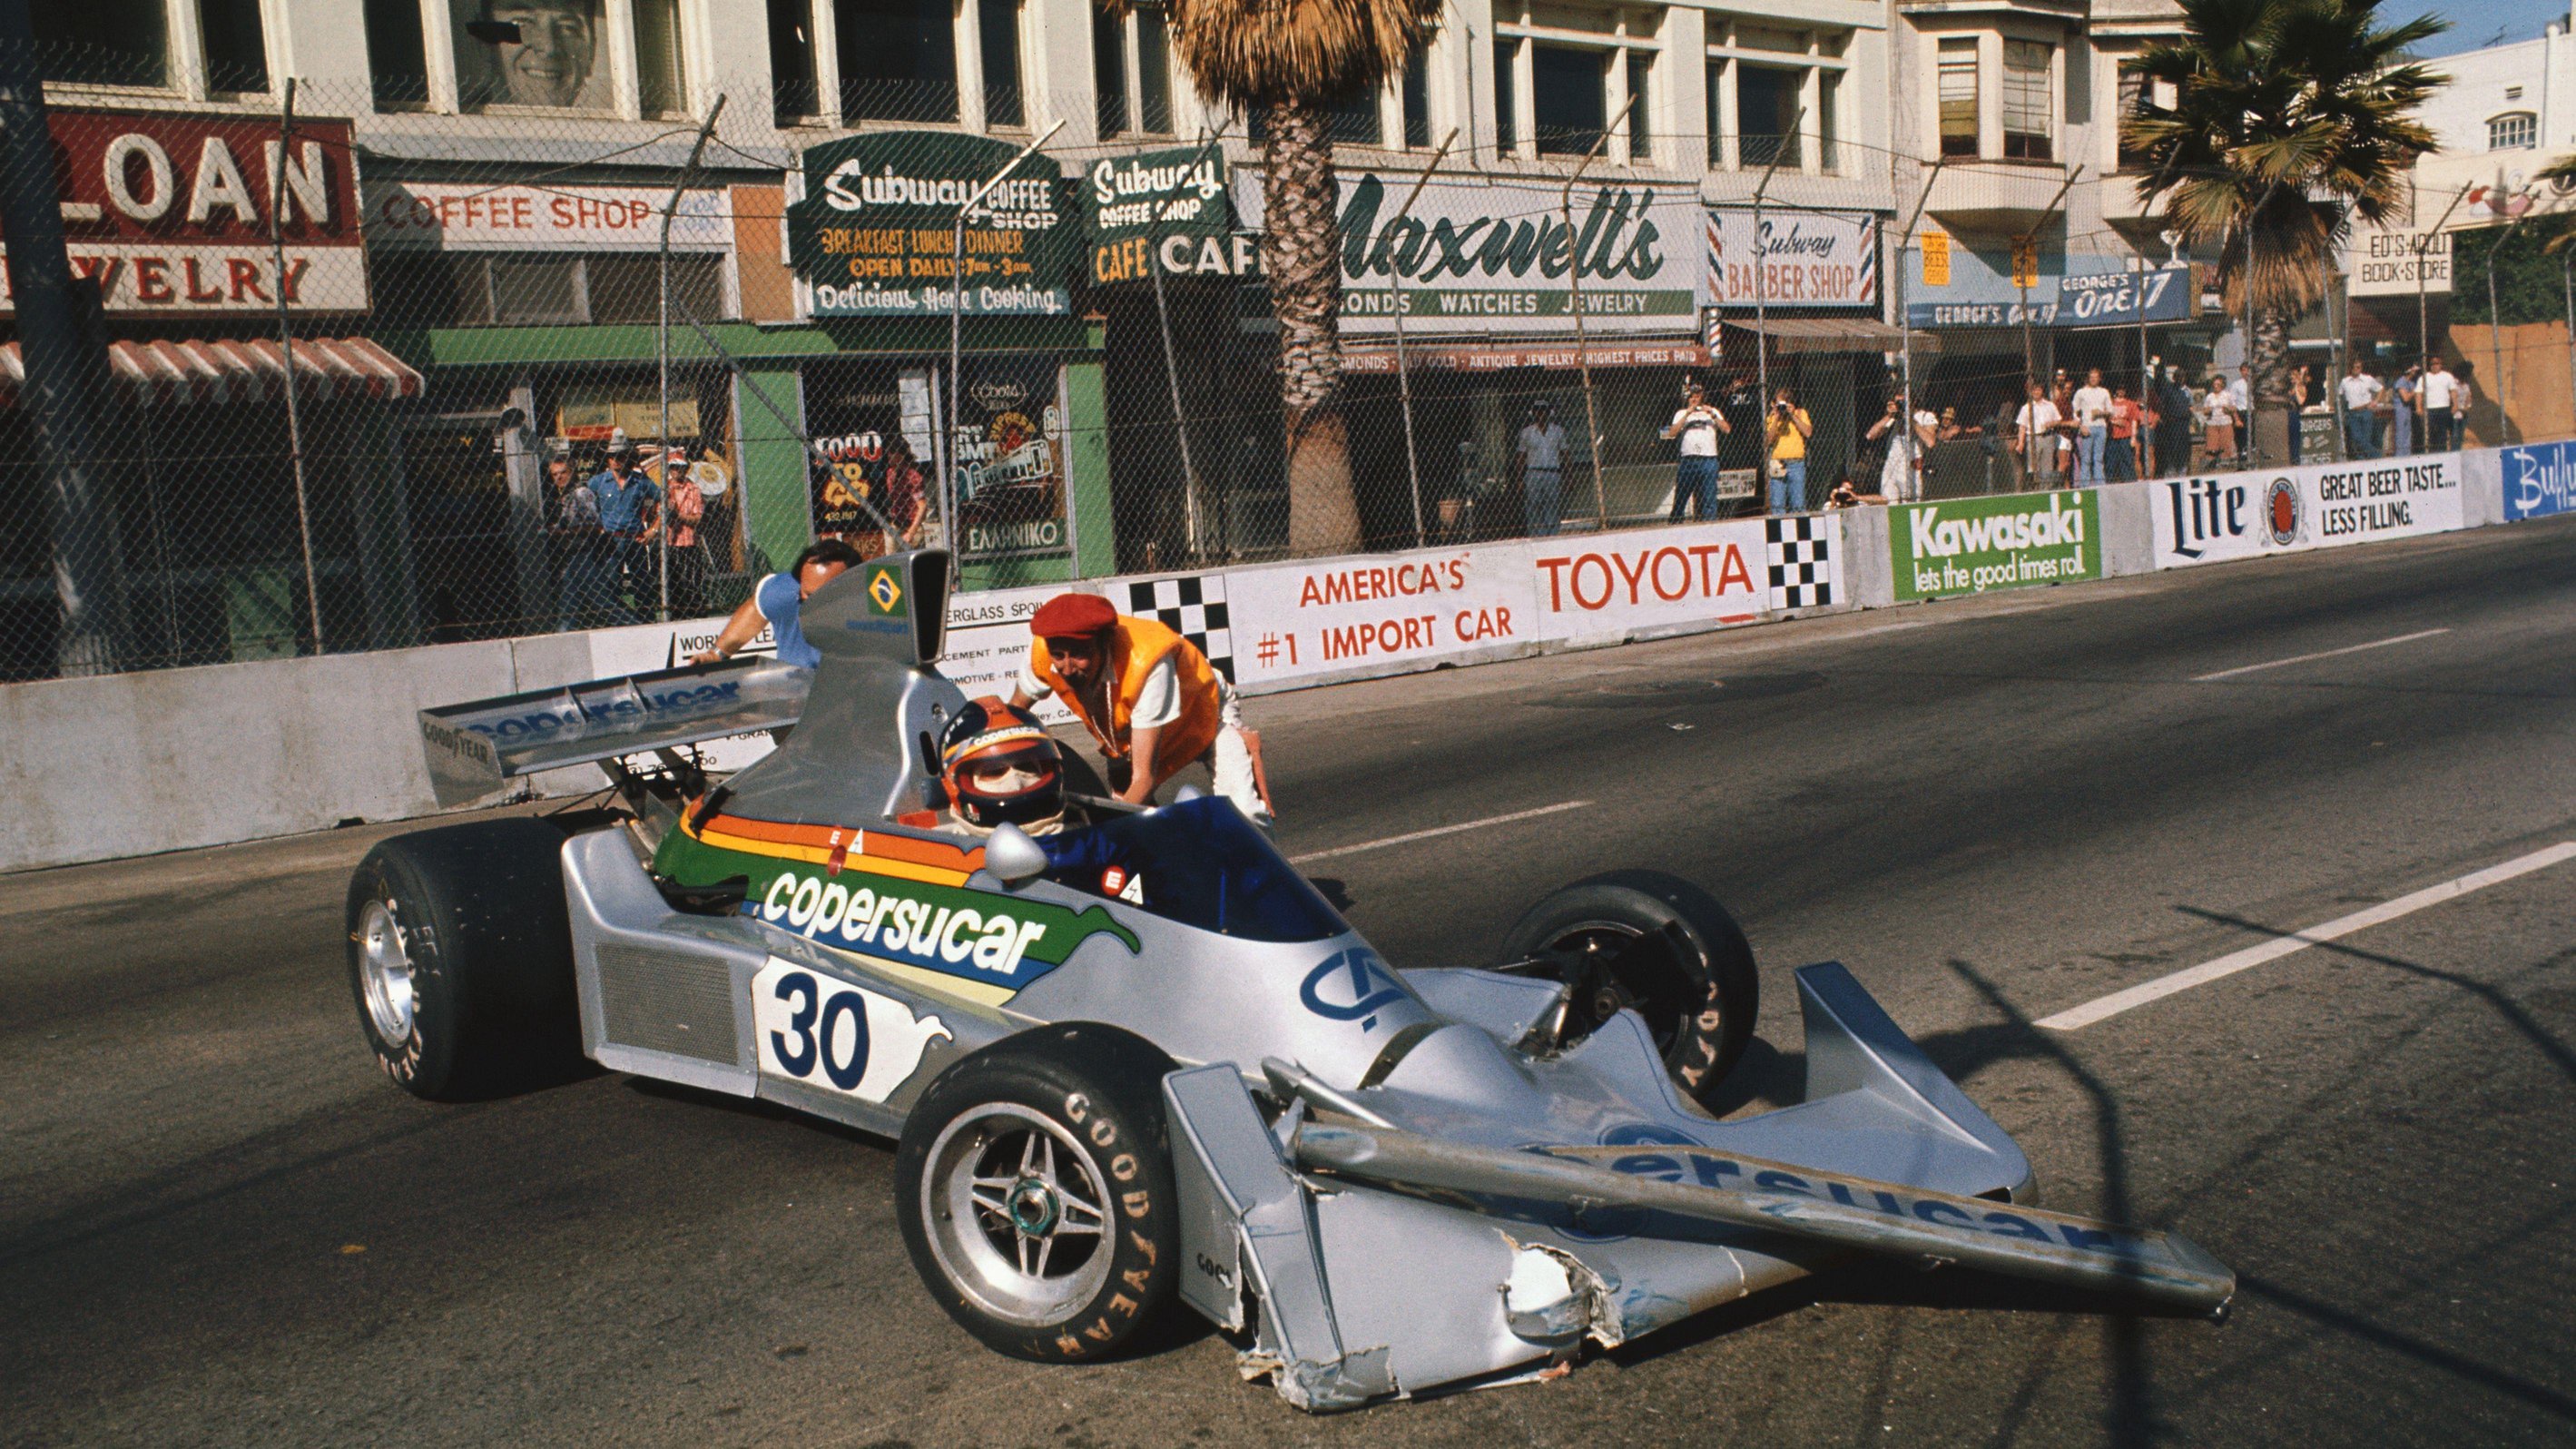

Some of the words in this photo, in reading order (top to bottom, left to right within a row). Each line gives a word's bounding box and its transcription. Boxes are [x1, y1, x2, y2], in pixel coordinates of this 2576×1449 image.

[824, 159, 991, 224] Subway
[988, 180, 1052, 211] COFFEE
[1094, 160, 1222, 203] Subway
[382, 195, 532, 229] COFFEE
[552, 199, 650, 229] SHOP
[991, 212, 1058, 229] SHOP
[1099, 202, 1151, 228] COFFEE
[821, 229, 906, 255] BREAKFAST
[911, 230, 954, 253] LUNCH
[965, 231, 1025, 254] DINNER
[1749, 221, 1836, 258] Subway
[849, 258, 904, 276] OPEN
[1096, 238, 1148, 283] CAFE
[817, 282, 918, 310] Delicious
[1809, 264, 1854, 300] SHOP
[2062, 273, 2129, 291] GEORGE'S
[1339, 291, 1411, 314] ONDS
[1439, 293, 1537, 314] WATCHES
[1561, 293, 1647, 314] JEWELRY
[1469, 355, 1517, 368] ANTIQUE
[1524, 353, 1576, 367] JEWELRY
[1586, 351, 1630, 365] HIGHEST
[1635, 350, 1668, 363] PRICES
[1674, 350, 1696, 362] PAID
[2320, 473, 2363, 501] GREAT
[2368, 469, 2401, 495] BEER
[1910, 491, 2084, 559] Kawasaki
[2166, 478, 2246, 560] Lite
[2322, 508, 2356, 537] LESS
[2360, 501, 2413, 533] FILLING.
[1299, 557, 1464, 608] AMERICA'S
[1536, 542, 1755, 614] TOYOTA
[1944, 557, 1969, 589] the
[1973, 552, 2017, 591] good
[2020, 554, 2058, 582] times
[946, 605, 1005, 623] ERGLASS
[1011, 601, 1042, 617] SPOI
[680, 634, 720, 652] WOR
[941, 647, 991, 662] CEMENT
[998, 644, 1029, 656] PART
[1257, 632, 1297, 667] #1
[1323, 615, 1436, 661] IMPORT
[1454, 606, 1514, 643] CAR
[1004, 669, 1019, 679] RE
[763, 872, 1046, 974] copersucar
[771, 971, 870, 1090] 30
[1579, 1146, 2115, 1249] ersucar
